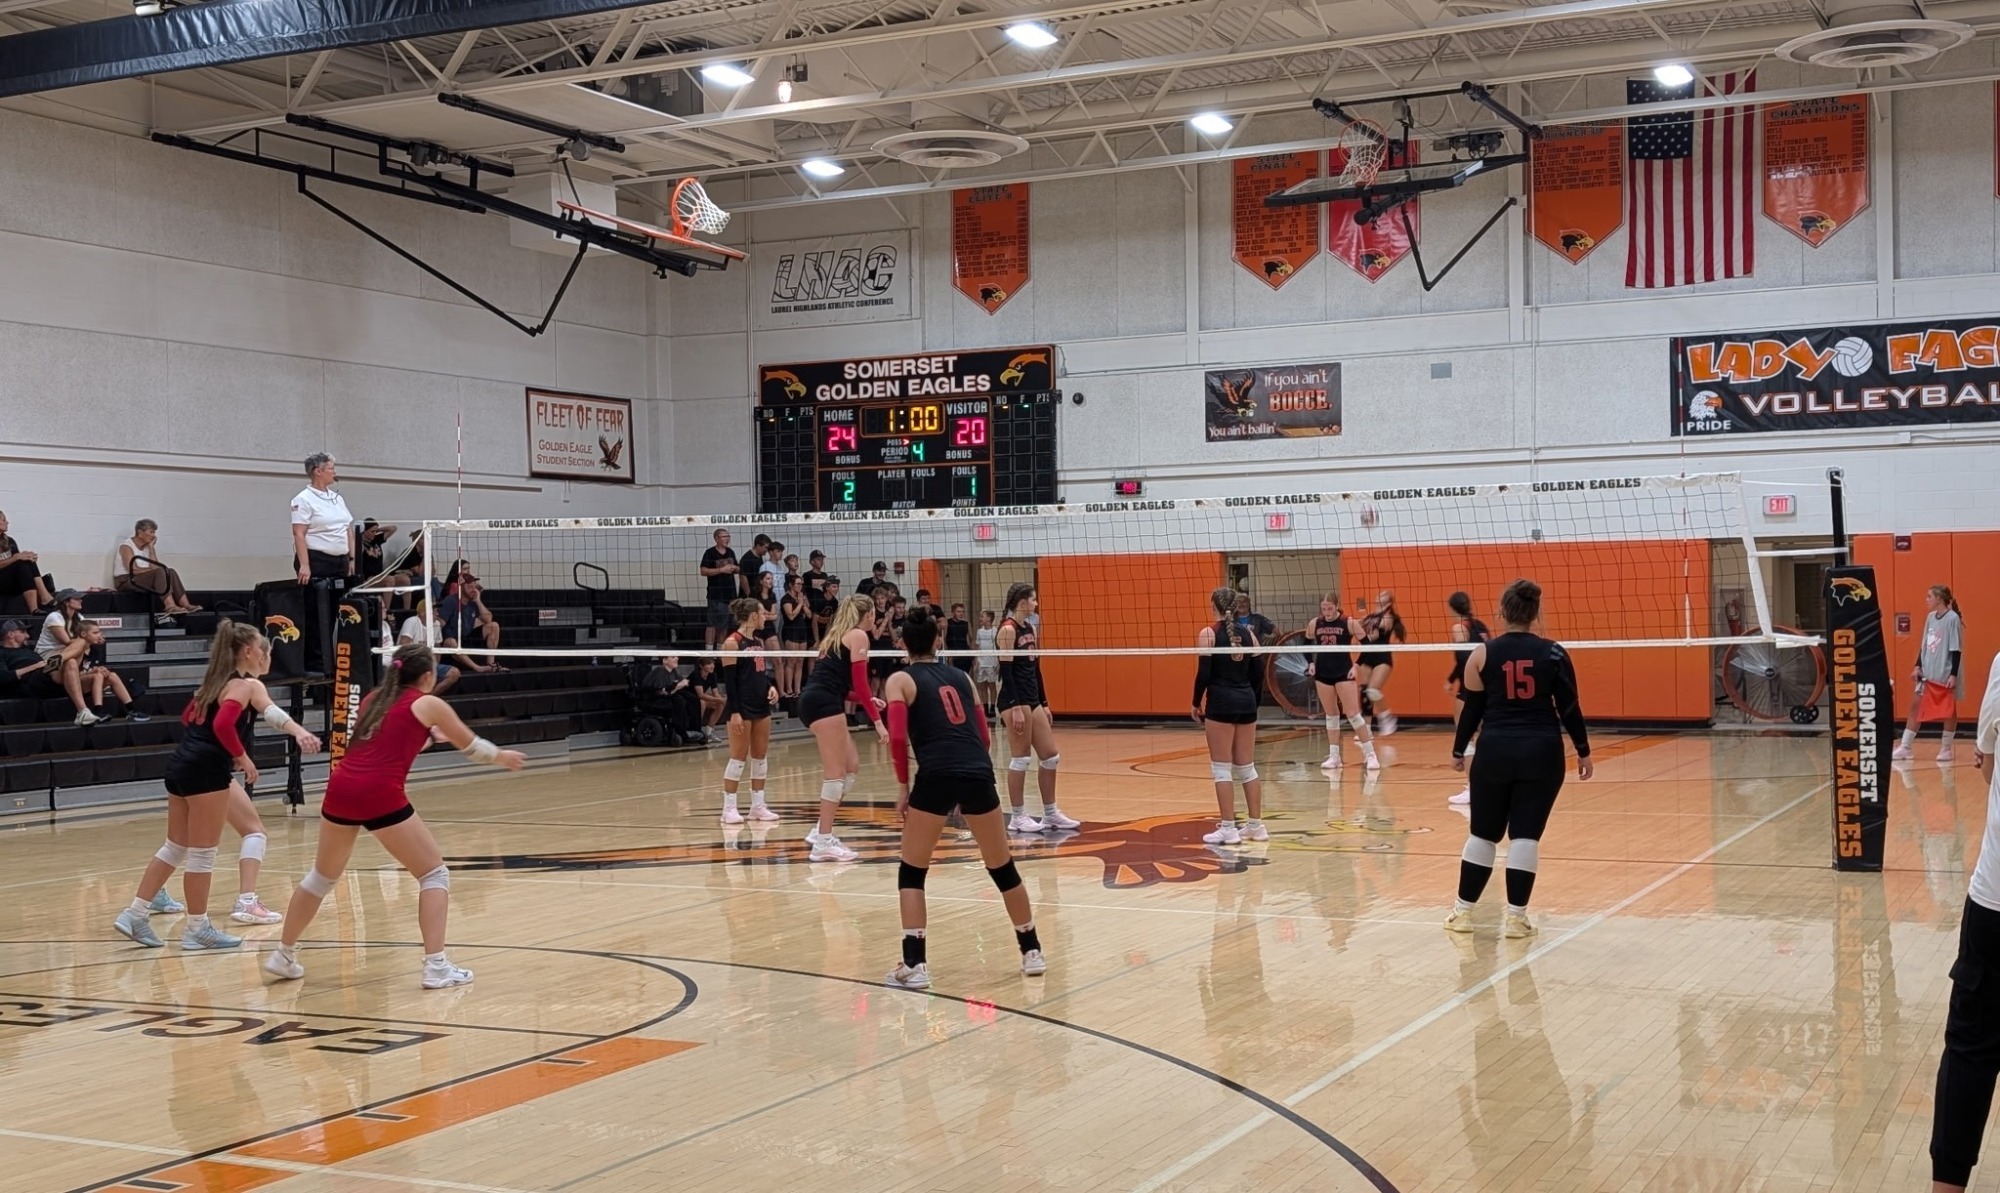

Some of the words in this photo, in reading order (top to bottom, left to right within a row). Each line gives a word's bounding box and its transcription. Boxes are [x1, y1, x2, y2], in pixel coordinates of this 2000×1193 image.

[1771, 103, 1860, 119] CHAMPIONS
[771, 303, 793, 314] LAUREL
[793, 302, 827, 313] HIGHLANDS
[827, 300, 855, 310] ATHLETIC
[855, 298, 894, 308] CONFERENCE
[1687, 337, 1837, 384] LADY
[1886, 326, 2000, 375] EAG
[844, 356, 958, 380] SOMERSET
[816, 380, 900, 401] GOLDEN
[908, 374, 991, 396] EAGLES
[1264, 372, 1274, 387] If
[1274, 374, 1299, 391] you
[1301, 369, 1328, 384] ain't
[1019, 394, 1025, 404] F
[800, 406, 814, 416] PTS
[823, 409, 854, 422] HOME
[946, 401, 988, 415] VISITOR
[536, 401, 574, 429] FLEET
[576, 404, 592, 431] OF
[595, 407, 624, 433] FEAR
[889, 405, 938, 432] 1:00
[956, 419, 985, 445] 20
[1209, 427, 1226, 438] You
[1227, 424, 1247, 436] ain't
[1248, 422, 1277, 435] ballin'
[1687, 420, 1731, 432] PRIDE
[539, 439, 568, 452] GOLDEN
[569, 442, 593, 454] EAGLE
[828, 427, 856, 451] 24
[880, 447, 909, 457] PERIOD
[912, 442, 924, 461] 4
[945, 450, 972, 460] BONUS
[536, 454, 567, 465] STUDENT
[568, 456, 595, 468] SECTION
[835, 455, 861, 465] BONUS
[831, 471, 856, 481] FOULS
[877, 469, 906, 479] PLAYER
[911, 468, 936, 477] FOULS
[952, 466, 977, 476] FOULS
[844, 482, 855, 501] 2
[971, 477, 976, 497] 1
[1532, 480, 1585, 493] GOLDEN
[1590, 477, 1641, 490] EAGLES
[1225, 496, 1271, 507] GOLDEN
[1275, 494, 1321, 505] EAGLES
[1373, 488, 1422, 501] GOLDEN
[1427, 486, 1476, 498] EAGLES
[833, 503, 856, 511] POINTS
[892, 501, 916, 509] MATCH
[951, 498, 976, 507] POINTS
[1086, 502, 1129, 513] GOLDEN
[1132, 500, 1176, 511] EAGLES
[710, 514, 748, 524] GOLDEN
[750, 513, 788, 523] EAGLES
[829, 511, 867, 521] GOLDEN
[871, 510, 910, 519] EAGLES
[954, 507, 994, 517] GOLDEN
[998, 506, 1038, 516] EAGLES
[488, 520, 523, 528] GOLDEN
[525, 519, 559, 528] EAGLES
[597, 517, 633, 526] GOLDEN
[636, 516, 671, 526] EAGLES
[333, 643, 351, 724] GOLDEN
[1501, 659, 1535, 699] 15
[1833, 629, 1859, 741] GOLDEN
[938, 685, 967, 725] 0
[1857, 683, 1879, 803] SOMERSET
[1836, 749, 1862, 858] EAGLES
